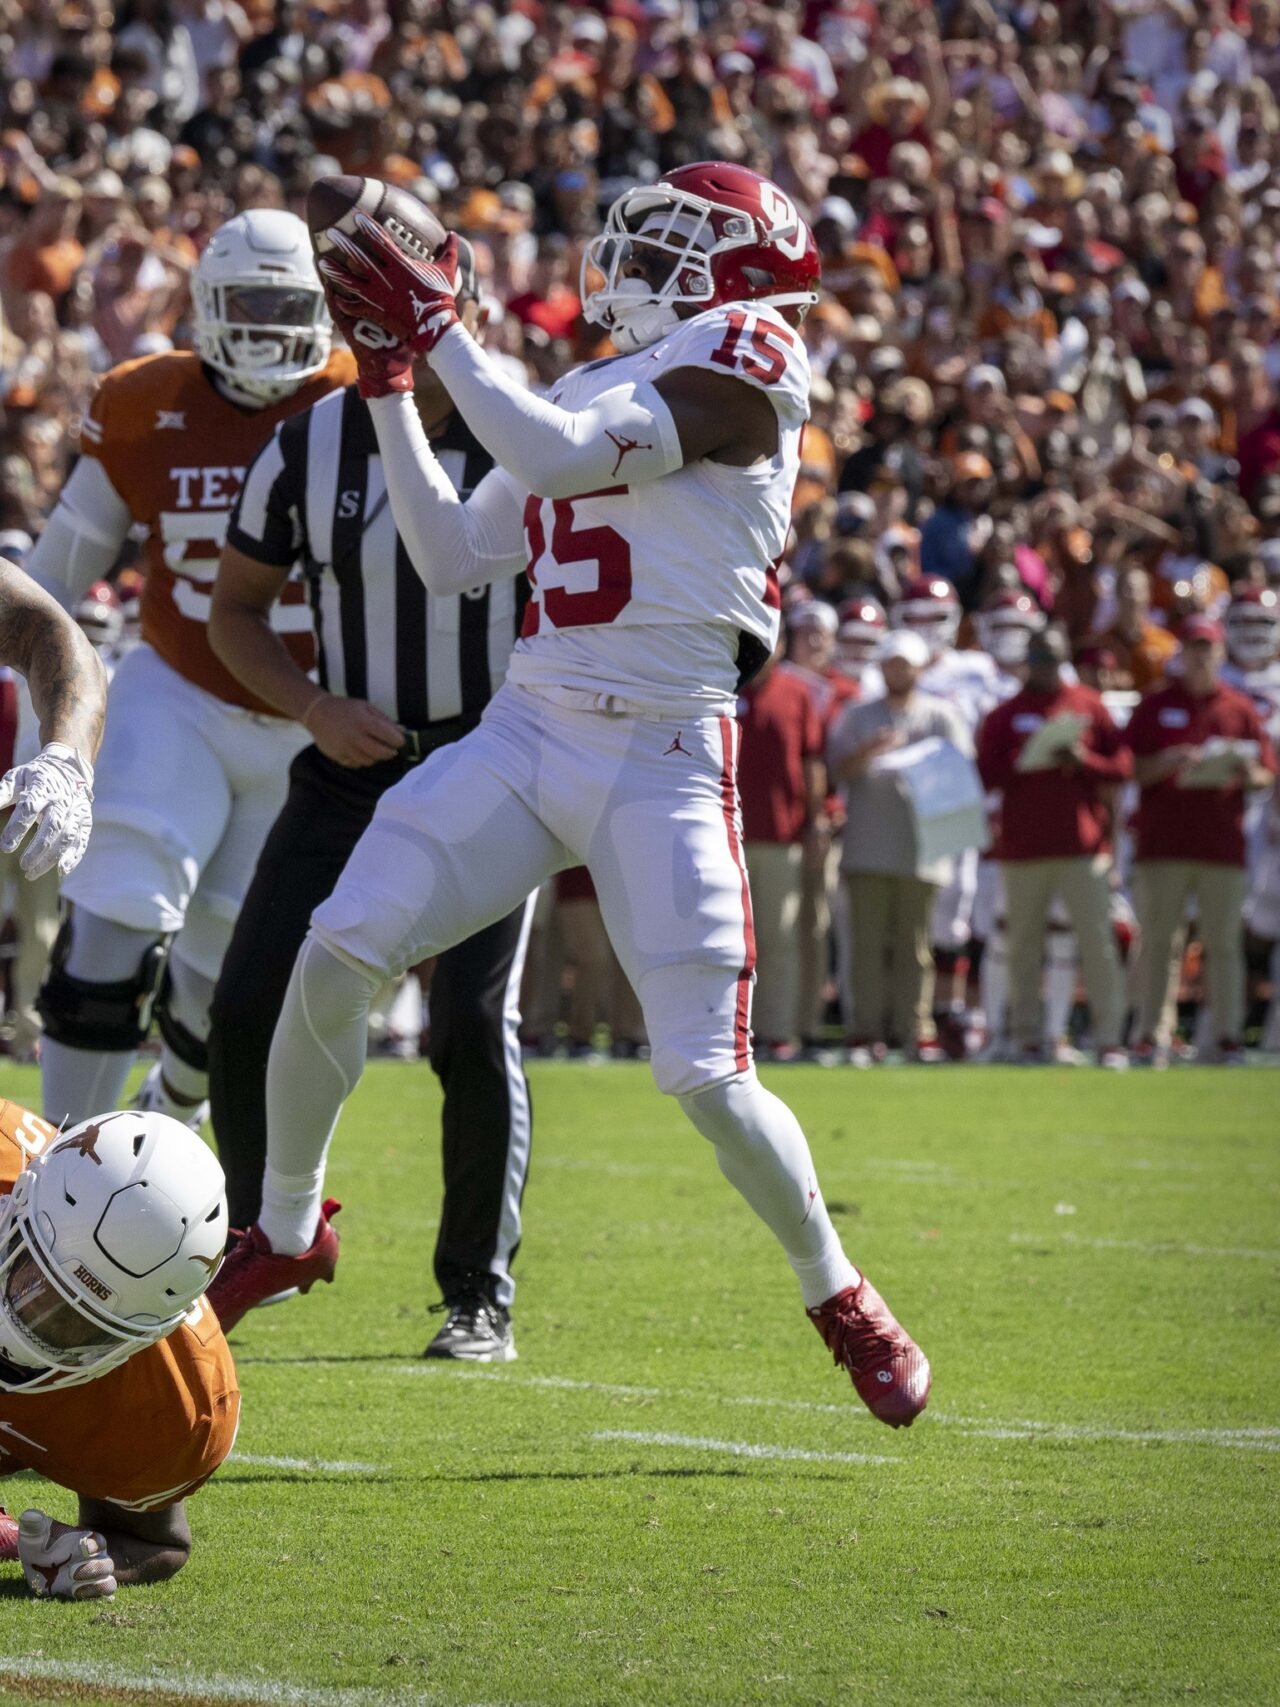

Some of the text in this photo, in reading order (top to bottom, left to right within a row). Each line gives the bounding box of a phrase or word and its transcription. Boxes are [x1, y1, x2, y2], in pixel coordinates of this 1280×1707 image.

[710, 311, 795, 386] 15
[337, 490, 360, 519] S
[521, 483, 633, 641] 15
[73, 1264, 113, 1302] HORNS
